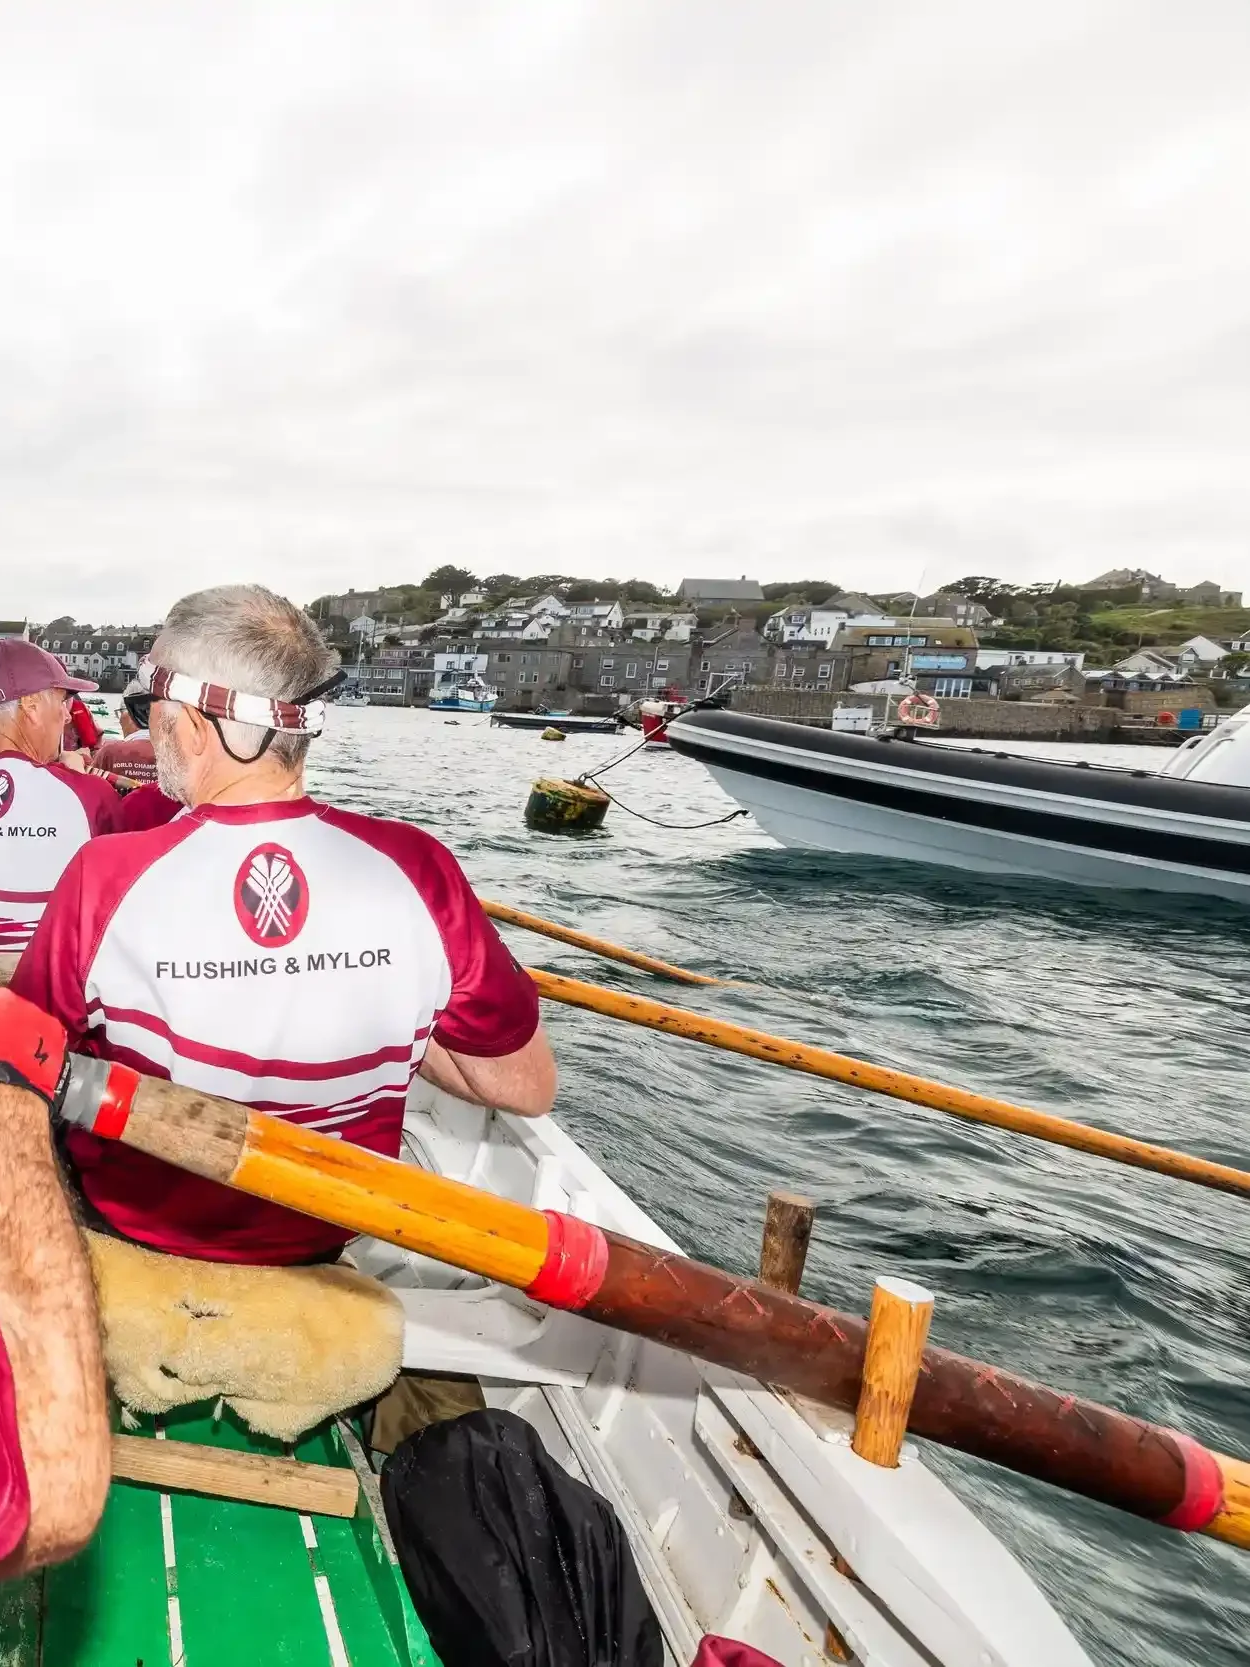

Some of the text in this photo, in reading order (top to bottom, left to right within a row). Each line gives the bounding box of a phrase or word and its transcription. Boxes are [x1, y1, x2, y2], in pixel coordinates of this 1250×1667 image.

[7, 826, 57, 838] MYLOR
[155, 948, 392, 980] FLUSHING & MYLOR
